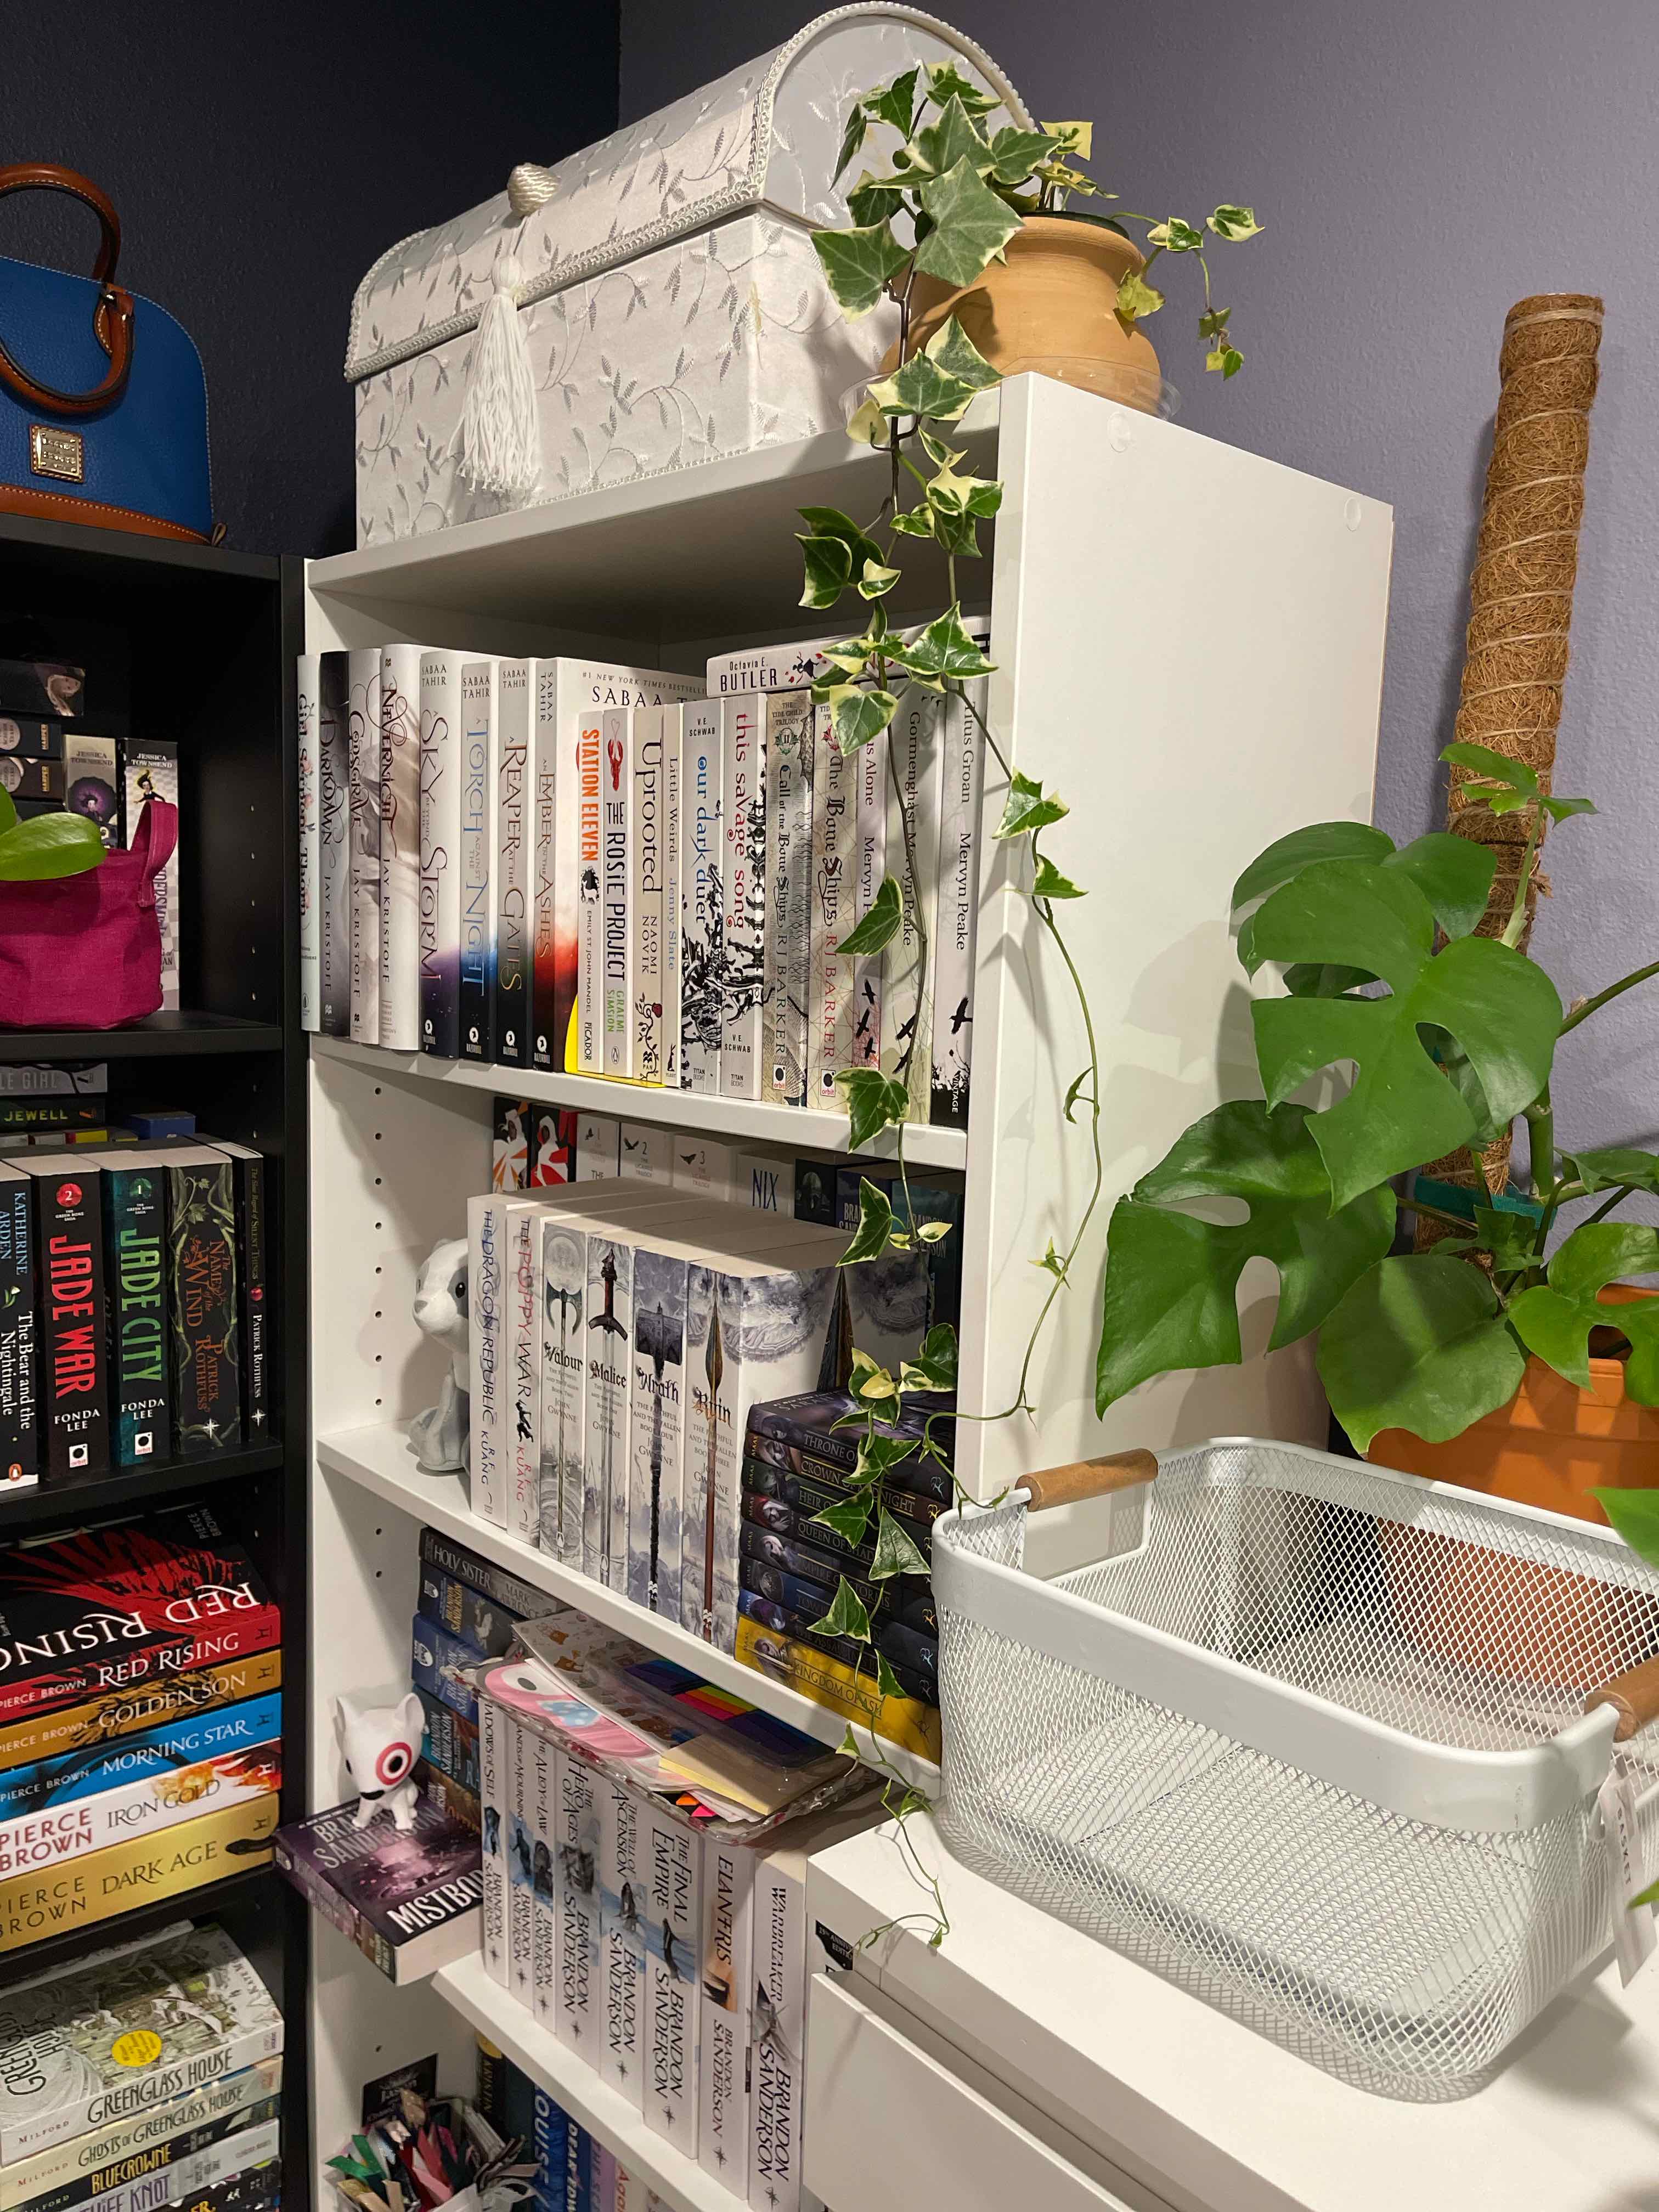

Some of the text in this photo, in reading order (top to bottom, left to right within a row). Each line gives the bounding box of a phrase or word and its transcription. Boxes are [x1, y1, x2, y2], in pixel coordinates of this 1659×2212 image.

[420, 664, 448, 674] SABAA
[421, 678, 448, 687] TAHIR
[462, 678, 490, 686] SABAA
[462, 690, 490, 699] TAHIR
[596, 673, 615, 681] NEW
[618, 676, 640, 685] YORK
[642, 680, 666, 689] TIMES
[720, 668, 777, 692] BUTLER
[729, 661, 758, 672] Octavia
[689, 727, 715, 737] SCHWAB
[775, 718, 800, 726] TRILOGY
[131, 759, 172, 768] TOWNSEND
[137, 753, 167, 761] JESSICA
[463, 719, 489, 834] TORCH
[865, 759, 877, 805] Alone
[902, 712, 922, 825] Gormenghast
[960, 749, 974, 803] Groan
[582, 729, 600, 861] STATION ELEVEN
[635, 738, 663, 895] Uprooted
[668, 757, 678, 862] Little Weirds
[726, 713, 759, 929] this savage song
[778, 765, 797, 872] Call of the Bone
[826, 755, 845, 852] The Bone
[500, 742, 527, 991] REAPER GATES
[534, 772, 555, 959] EMBER ASHES
[696, 755, 715, 924] our duet
[862, 837, 876, 898] Mervyn
[382, 859, 391, 983] JAY KRISTOFF
[420, 838, 448, 979] STORM
[606, 802, 625, 981] THE PROJECT
[667, 877, 677, 970] Jenny Slate
[955, 832, 972, 951] Mervyn Peake
[461, 870, 489, 996] NIGHT
[650, 916, 658, 975] NAOMI
[584, 1021, 593, 1061] PICADOR
[775, 966, 787, 1054] BARKER
[823, 967, 837, 1059] BARKER
[724, 1043, 751, 1053] SCHWAB
[4, 1109, 69, 1122] JEWELL
[138, 1184, 142, 1194] 1
[699, 1150, 706, 1165] 3
[65, 1190, 72, 1201] 2
[14, 1192, 28, 1276] KATHERINE
[50, 1235, 96, 1400] JADE WAR
[120, 1228, 163, 1382] JADE CITY
[482, 1209, 494, 1425] THE DRAGON REPUBLIC
[517, 1250, 532, 1397] POPPY WAR
[0, 1329, 17, 1415] Nightingale
[18, 1310, 36, 1430] The Bear and the
[54, 1408, 101, 1425] FONDA
[66, 1422, 89, 1432] LEE
[121, 1398, 165, 1413] FONDA
[133, 1409, 154, 1420] LEE
[516, 1445, 524, 1503] KUANG
[800, 1460, 840, 1485] CROWN
[804, 1434, 845, 1459] THRONE
[799, 1489, 822, 1508] HEIR
[798, 1523, 831, 1546] QUEEN
[433, 1544, 493, 1590] HOLY SISTER
[164, 1581, 261, 1625] RED
[41, 1678, 87, 1699] BROWN
[98, 1632, 240, 1688] RED RISING
[795, 1664, 843, 1697] KINGDOM
[42, 1720, 89, 1741] BROWN
[98, 1671, 247, 1728] GOLDEN SON
[102, 1719, 254, 1776] MORNING STAR
[0, 1768, 89, 1803] PIERCE BROWN
[107, 1779, 221, 1829] IRON GOLD
[568, 1757, 589, 1809] HERO
[584, 1788, 593, 1808] THE
[628, 1804, 637, 1826] THE
[611, 1782, 630, 1878] ASCENSION
[1617, 1806, 1633, 1884] BASKET
[101, 1839, 219, 1895] DARK AGE
[652, 1827, 675, 1910] EMPIRE
[670, 1859, 692, 1923] FINAL
[493, 1872, 504, 1938] BRANDON
[521, 1893, 531, 1961] BRANDON
[714, 1854, 733, 1966] ELANTRIS
[543, 1920, 553, 1987] BRANDON
[562, 1891, 576, 2015] SANDERSON
[575, 1911, 590, 2013] BRANDON
[769, 1887, 787, 2002] WARBREAKER
[607, 1927, 623, 2054] SANDERSON
[623, 1948, 636, 2053] BRANDON
[652, 1967, 669, 2099] SANDERSON
[668, 1989, 684, 2098] BRANDON
[87, 2068, 183, 2124] GREENGLASS
[187, 2047, 234, 2089] HOUSE
[712, 2018, 725, 2138] SANDERSON
[724, 2028, 733, 2103] BRANDON
[78, 2133, 121, 2167] GHOSTS
[132, 2098, 205, 2143] GREENGLASS
[208, 2084, 244, 2114] HOUSE
[755, 2042, 774, 2181] SANDERSON
[775, 2067, 791, 2182] BRANDON
[91, 2142, 172, 2195] BLUECROWNE
[130, 2173, 171, 2211] KNOT
